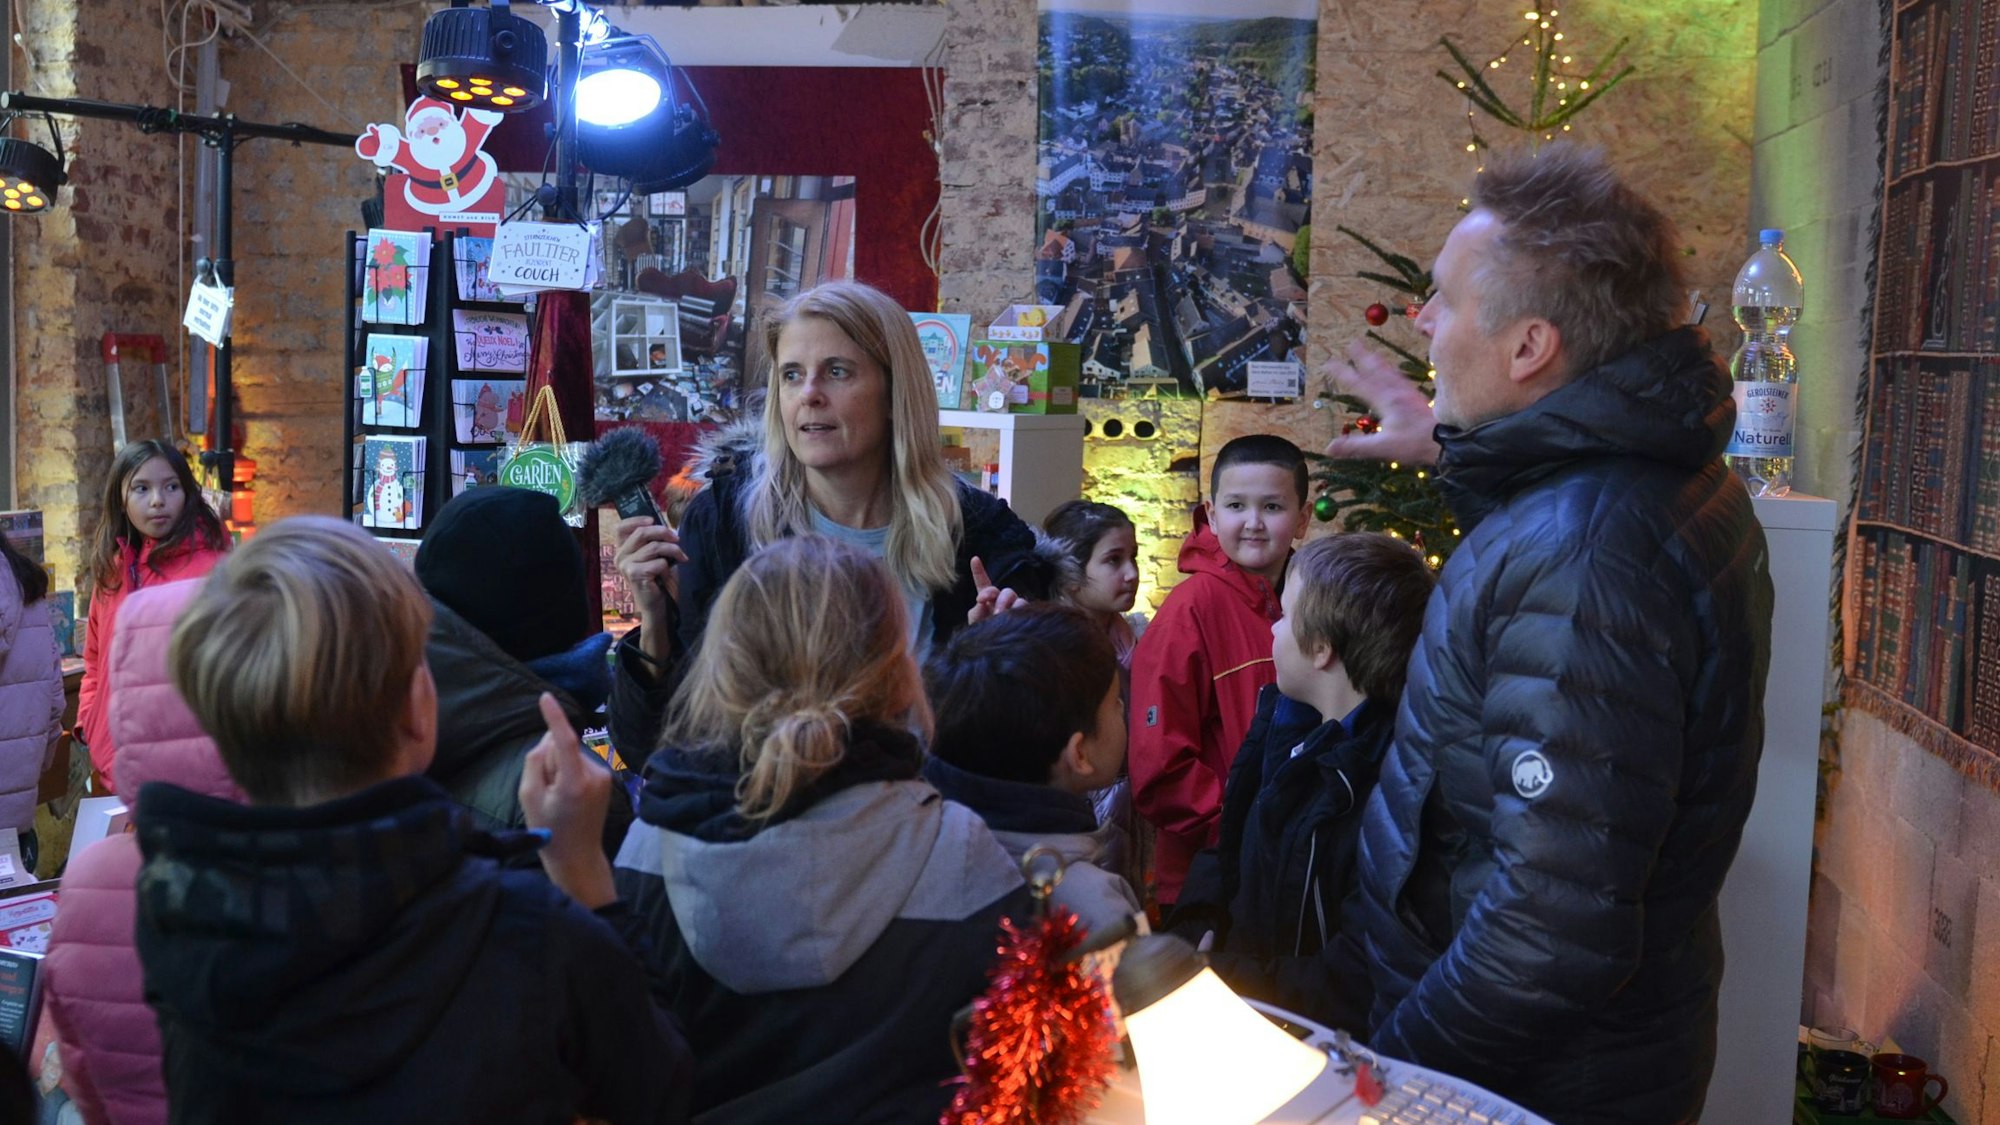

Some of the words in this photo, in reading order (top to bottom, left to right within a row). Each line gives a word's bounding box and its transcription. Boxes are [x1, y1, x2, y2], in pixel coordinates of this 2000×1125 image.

[501, 242, 580, 265] FAULTIER
[514, 266, 560, 282] COUCH
[1746, 387, 1789, 400] GEROLSTEINER
[1734, 430, 1792, 446] Naturell
[509, 457, 562, 489] GARTEN
